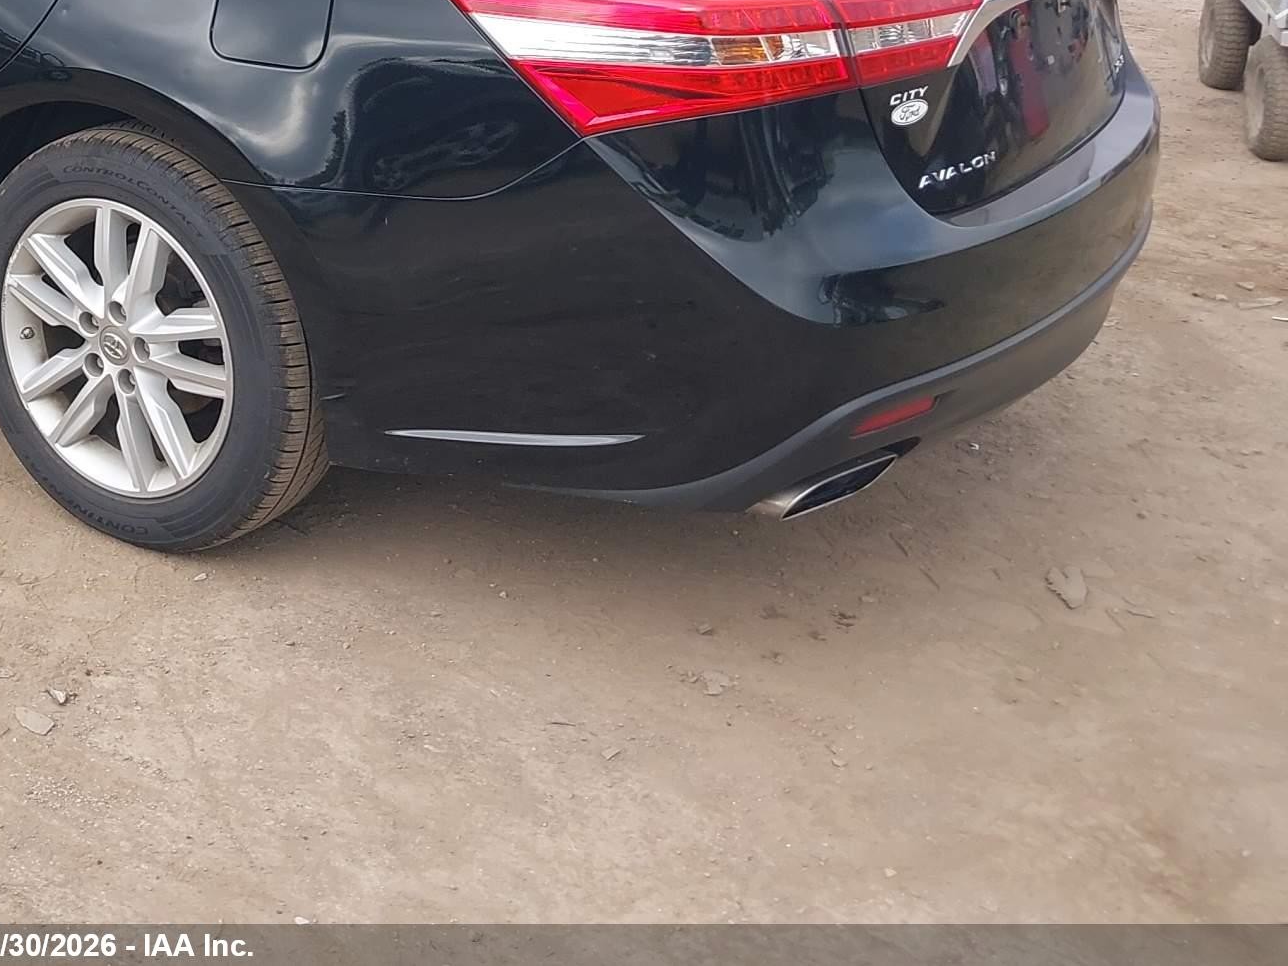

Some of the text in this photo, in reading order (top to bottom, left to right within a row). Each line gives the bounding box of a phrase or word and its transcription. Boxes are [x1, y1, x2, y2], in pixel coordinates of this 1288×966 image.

[890, 85, 929, 106] CITY
[895, 102, 925, 123] Ford
[918, 150, 996, 189] AVALON
